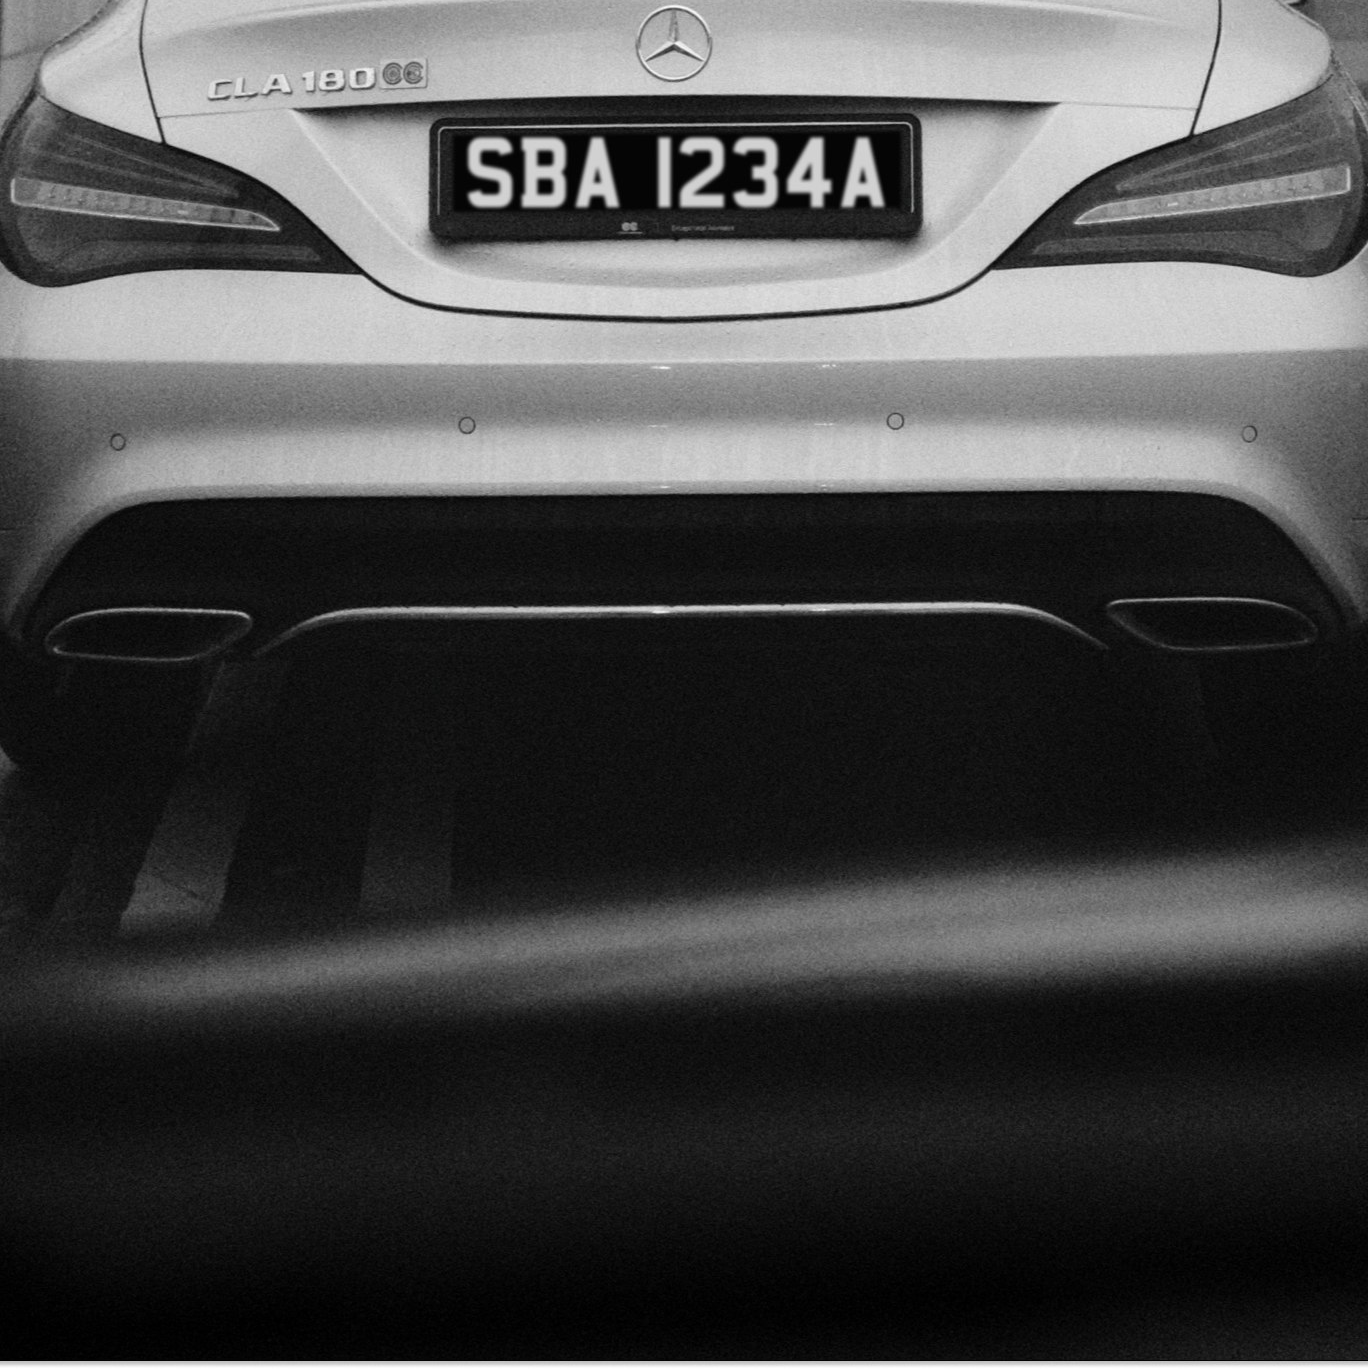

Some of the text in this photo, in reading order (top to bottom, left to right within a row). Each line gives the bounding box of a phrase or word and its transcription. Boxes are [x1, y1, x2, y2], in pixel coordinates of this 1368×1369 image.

[207, 67, 377, 101] CLA 180
[467, 136, 886, 209] SBA 1234A
